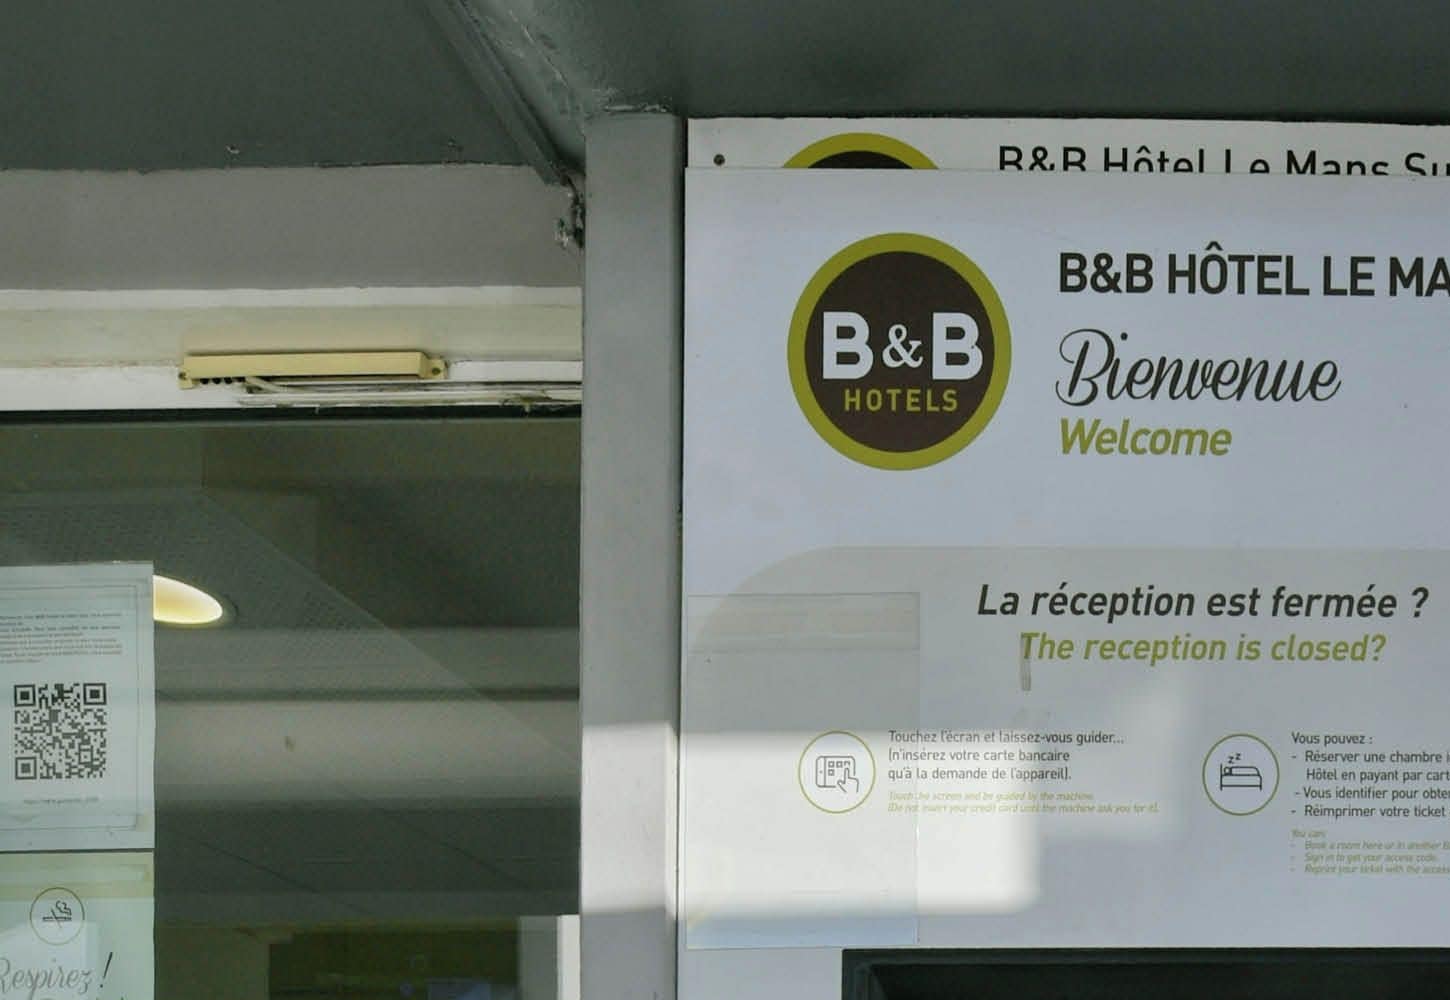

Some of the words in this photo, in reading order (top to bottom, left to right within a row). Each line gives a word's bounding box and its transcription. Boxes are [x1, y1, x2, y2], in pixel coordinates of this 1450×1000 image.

[1060, 252, 1153, 294] B&B
[1168, 242, 1310, 296] HÔTEL
[1323, 256, 1375, 296] LE
[822, 311, 984, 380] B&B
[1056, 329, 1342, 406] Bienvenue
[845, 389, 958, 412] HOTELS
[1060, 414, 1232, 456] Welcome
[978, 584, 1019, 615] La
[1032, 582, 1195, 623] réception
[1207, 588, 1261, 616] est
[1272, 584, 1397, 618] fermée
[1412, 587, 1429, 618] ?
[1021, 632, 1077, 662] The
[1082, 633, 1226, 667] reception
[1236, 633, 1261, 661] is
[1271, 634, 1386, 662] closed?
[888, 730, 938, 746] Touchez
[941, 730, 980, 744] l'écran
[984, 731, 995, 742] et
[999, 730, 1072, 746] laissez-vous
[1076, 730, 1124, 746] guider...
[1306, 768, 1338, 780] Hôtel
[1341, 766, 1358, 782] en
[1360, 768, 1401, 785] payant
[1402, 766, 1424, 784] par
